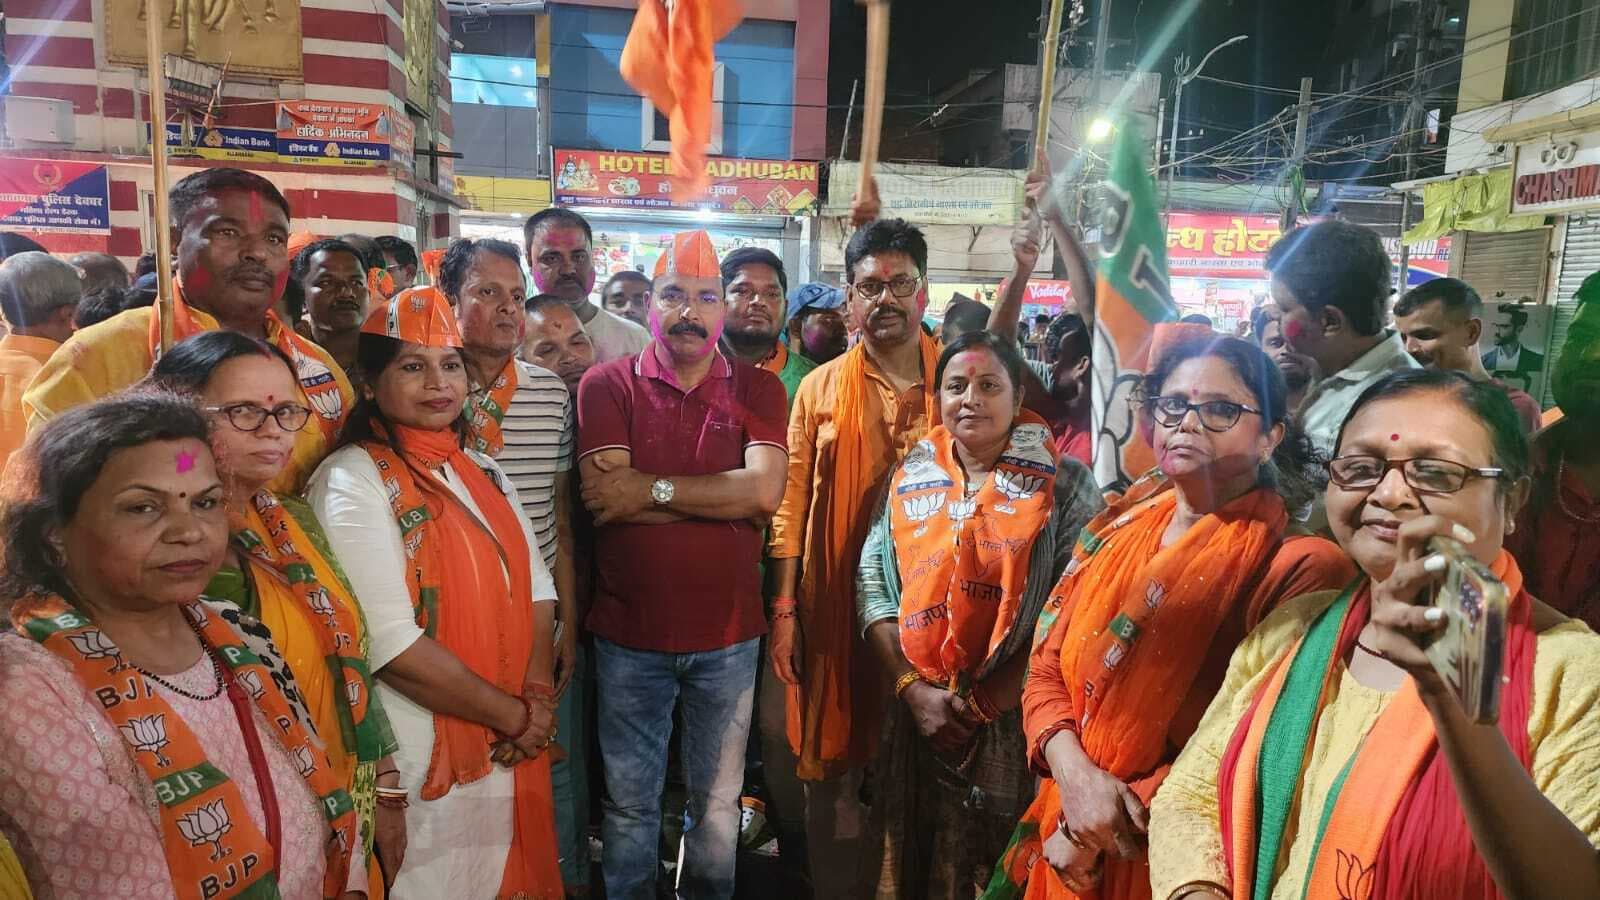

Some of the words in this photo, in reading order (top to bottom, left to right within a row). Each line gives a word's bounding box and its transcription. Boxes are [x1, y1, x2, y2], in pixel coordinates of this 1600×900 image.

[225, 136, 250, 145] Indian
[251, 137, 271, 147] Bank
[342, 147, 363, 155] Indian
[364, 148, 380, 157] Bank
[707, 159, 815, 182] ADHUBAN
[1212, 217, 1281, 257] होट
[155, 771, 205, 806] BJP
[200, 853, 259, 900] BJP
